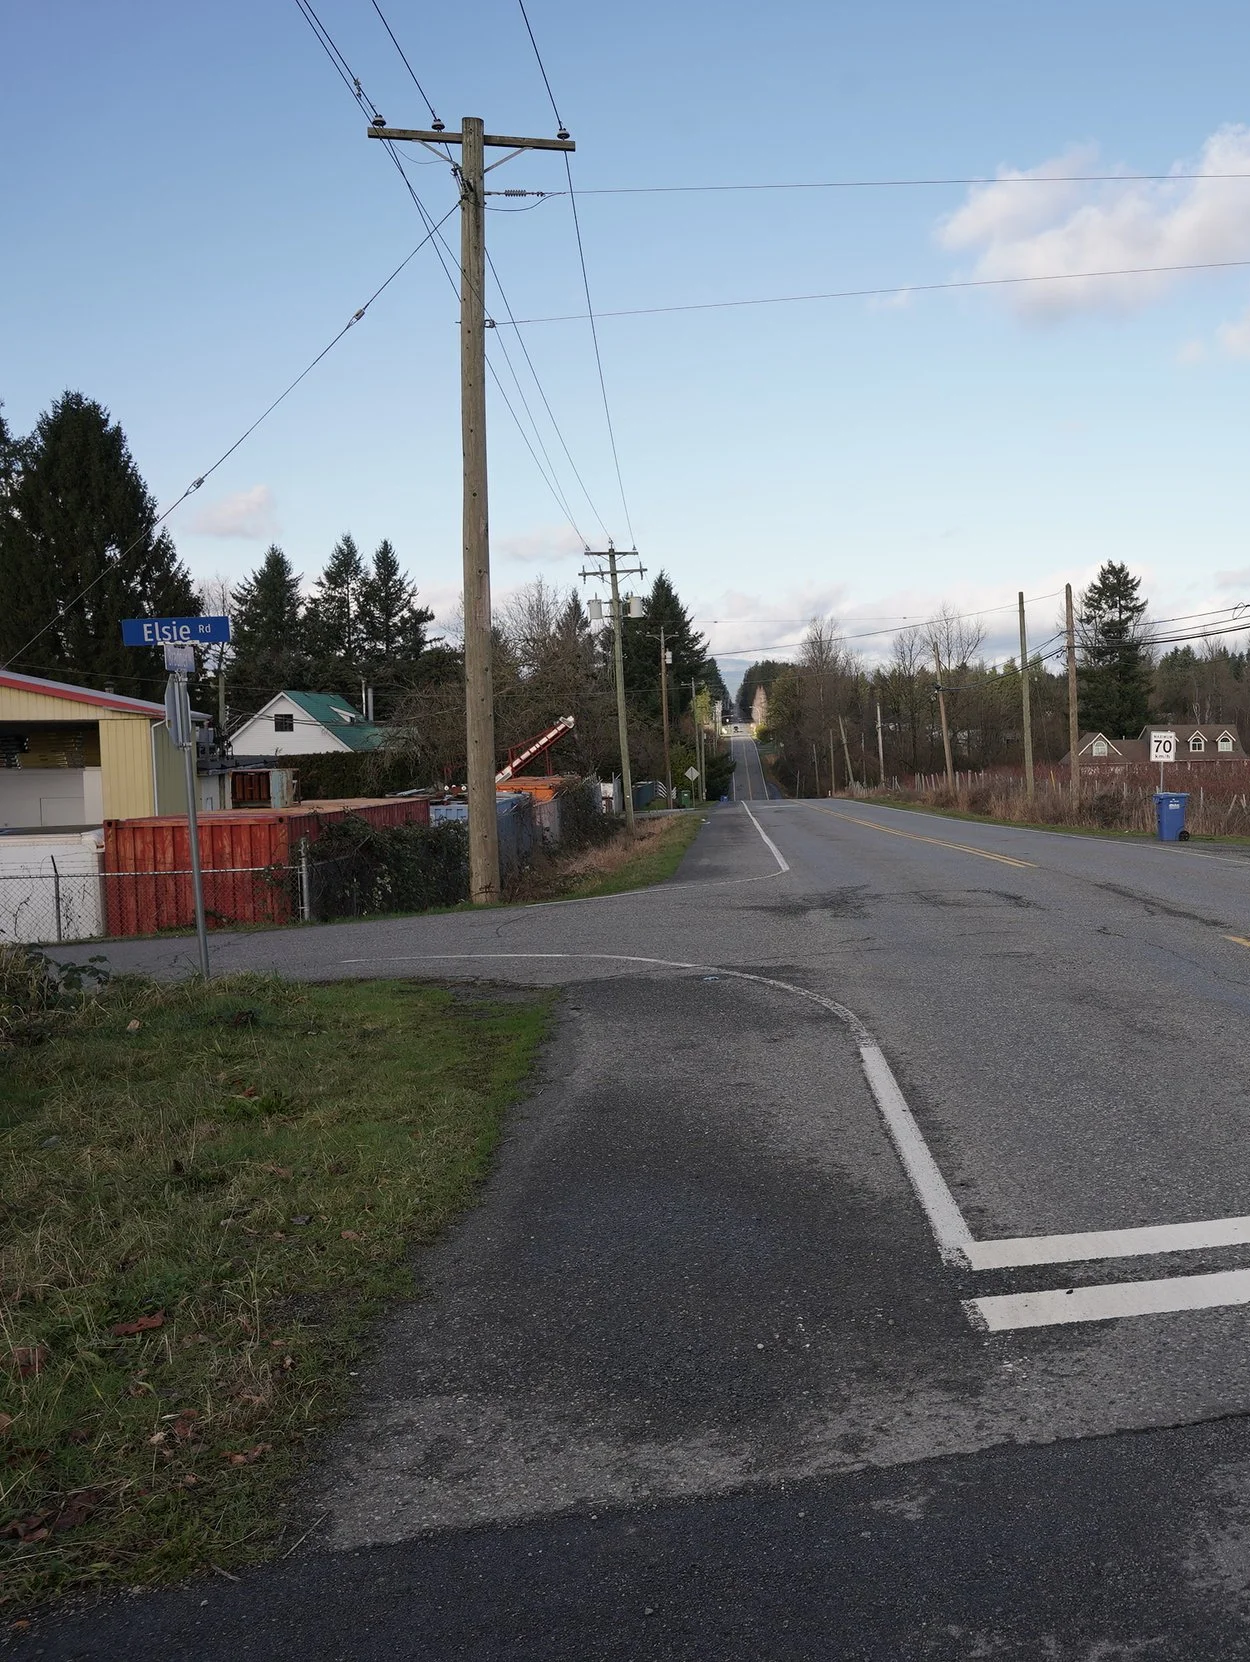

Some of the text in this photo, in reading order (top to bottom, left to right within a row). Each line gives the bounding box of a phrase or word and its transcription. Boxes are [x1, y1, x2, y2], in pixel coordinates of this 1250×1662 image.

[143, 621, 211, 642] Elsie Rd
[1154, 740, 1172, 753] 70
